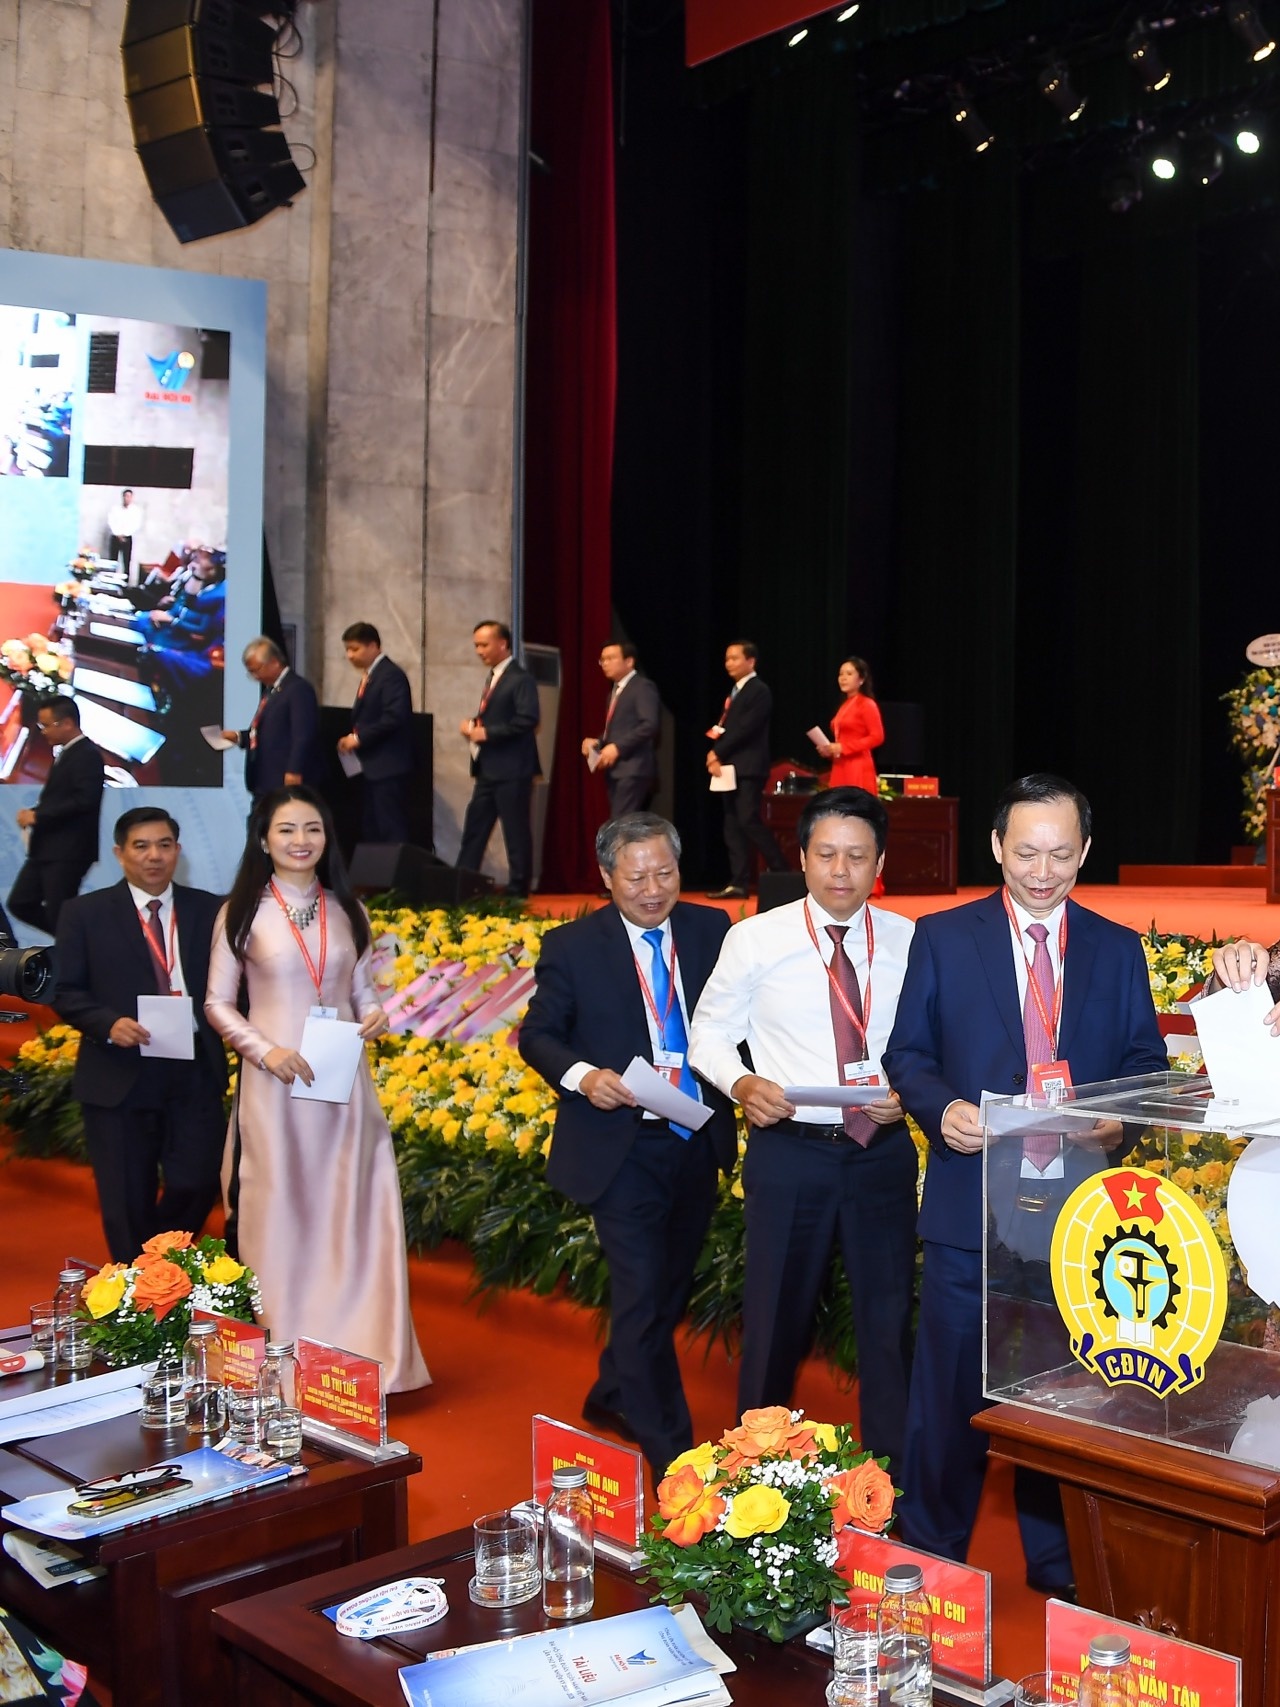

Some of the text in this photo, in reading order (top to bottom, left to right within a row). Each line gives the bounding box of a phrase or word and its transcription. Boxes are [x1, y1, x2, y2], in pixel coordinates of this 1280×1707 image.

[1105, 1352, 1167, 1390] CĐVN
[943, 1600, 966, 1624] CHI
[1138, 1673, 1168, 1703] VĂN
